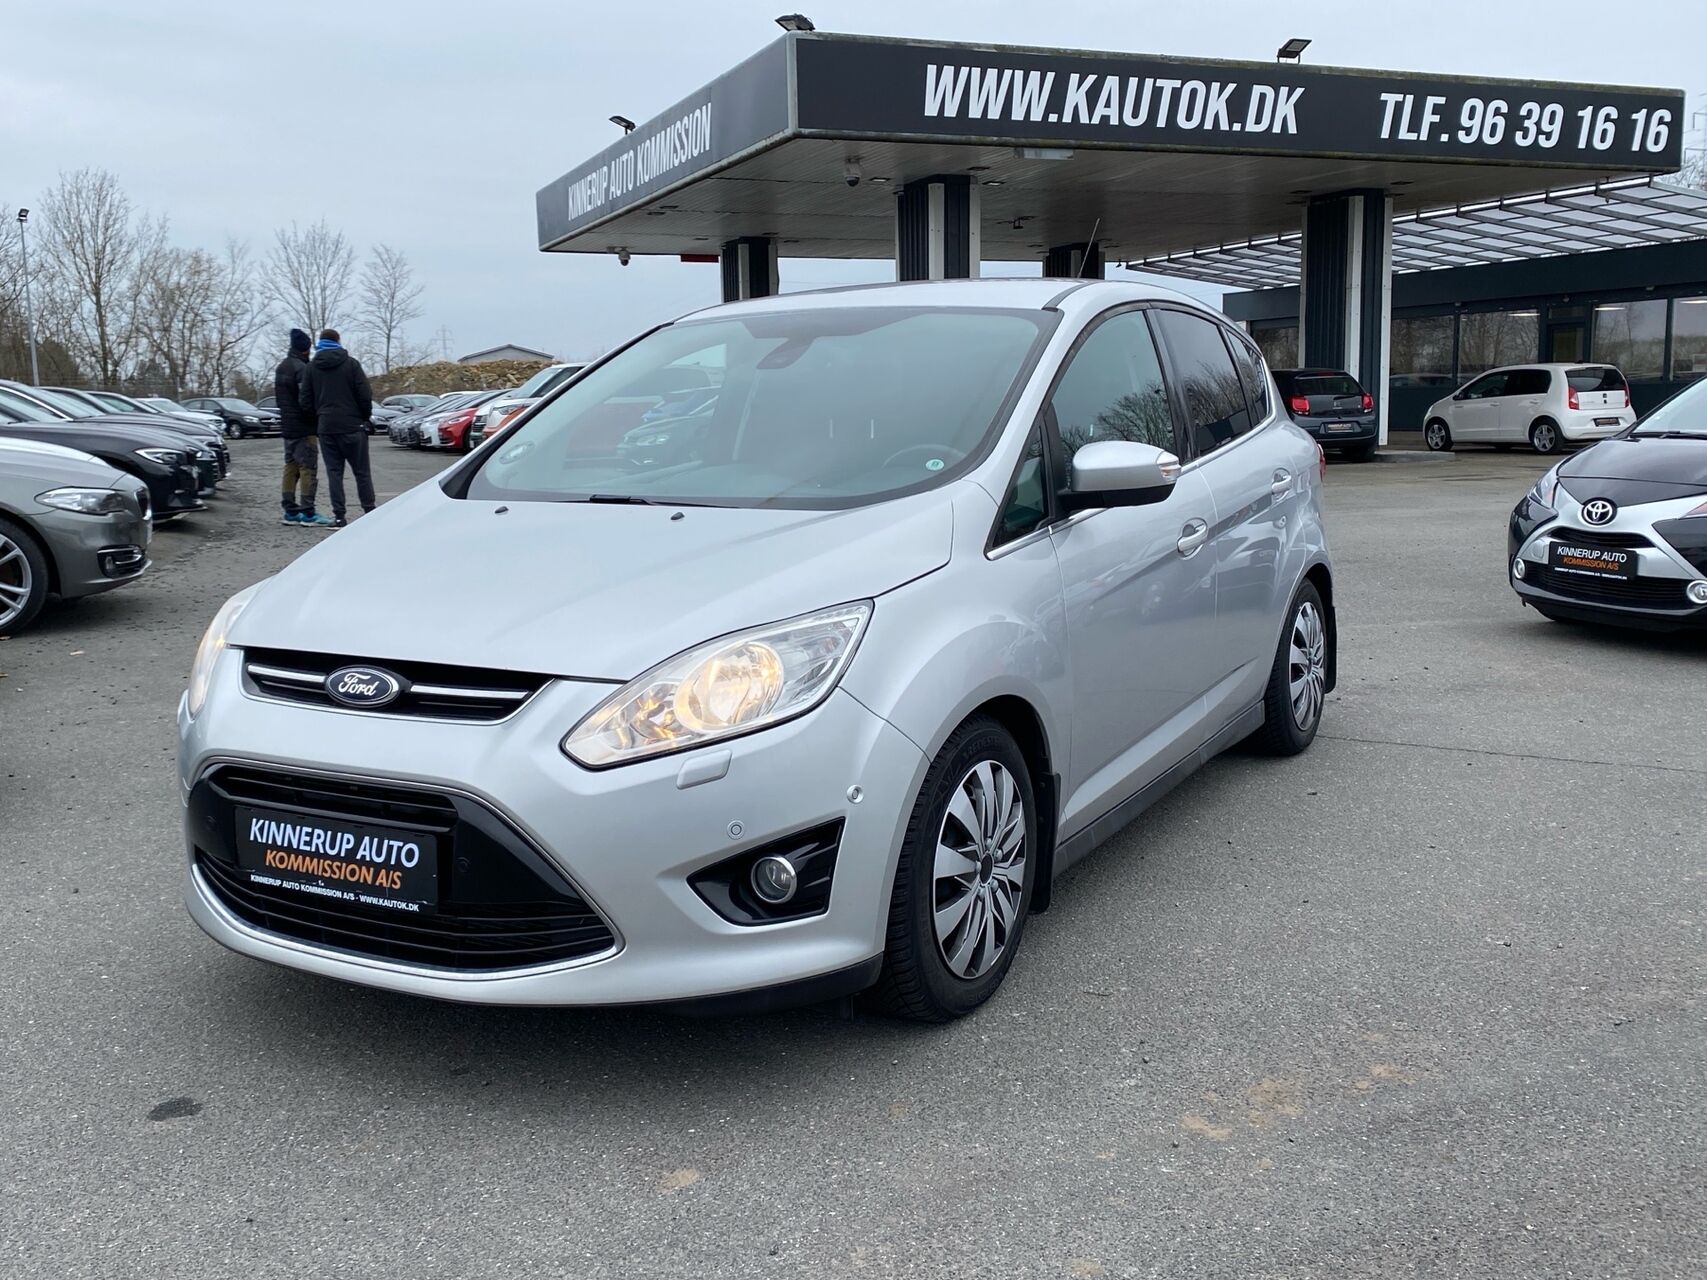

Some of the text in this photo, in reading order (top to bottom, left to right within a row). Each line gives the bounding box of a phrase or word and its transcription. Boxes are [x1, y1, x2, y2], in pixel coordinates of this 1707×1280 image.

[924, 64, 1305, 134] WWW.KAUTOK.DK
[1379, 93, 1672, 153] TLF. 96 39 16 16
[568, 102, 712, 221] KINNERUP AUTO KOMMISSION
[1557, 546, 1627, 563] KINNERUP AUTO
[1563, 557, 1620, 570] KOMMISSION A/S
[338, 672, 380, 696] Ford
[249, 818, 420, 868] KINNERUP AUTO
[265, 849, 403, 890] KOMMISSION A/S
[250, 874, 282, 887] KINNERUP
[282, 881, 300, 891] AUTO
[300, 884, 342, 899] KOMMISSION
[343, 891, 355, 901] A/S
[359, 894, 420, 912] WWW.KAUTOK.DK
